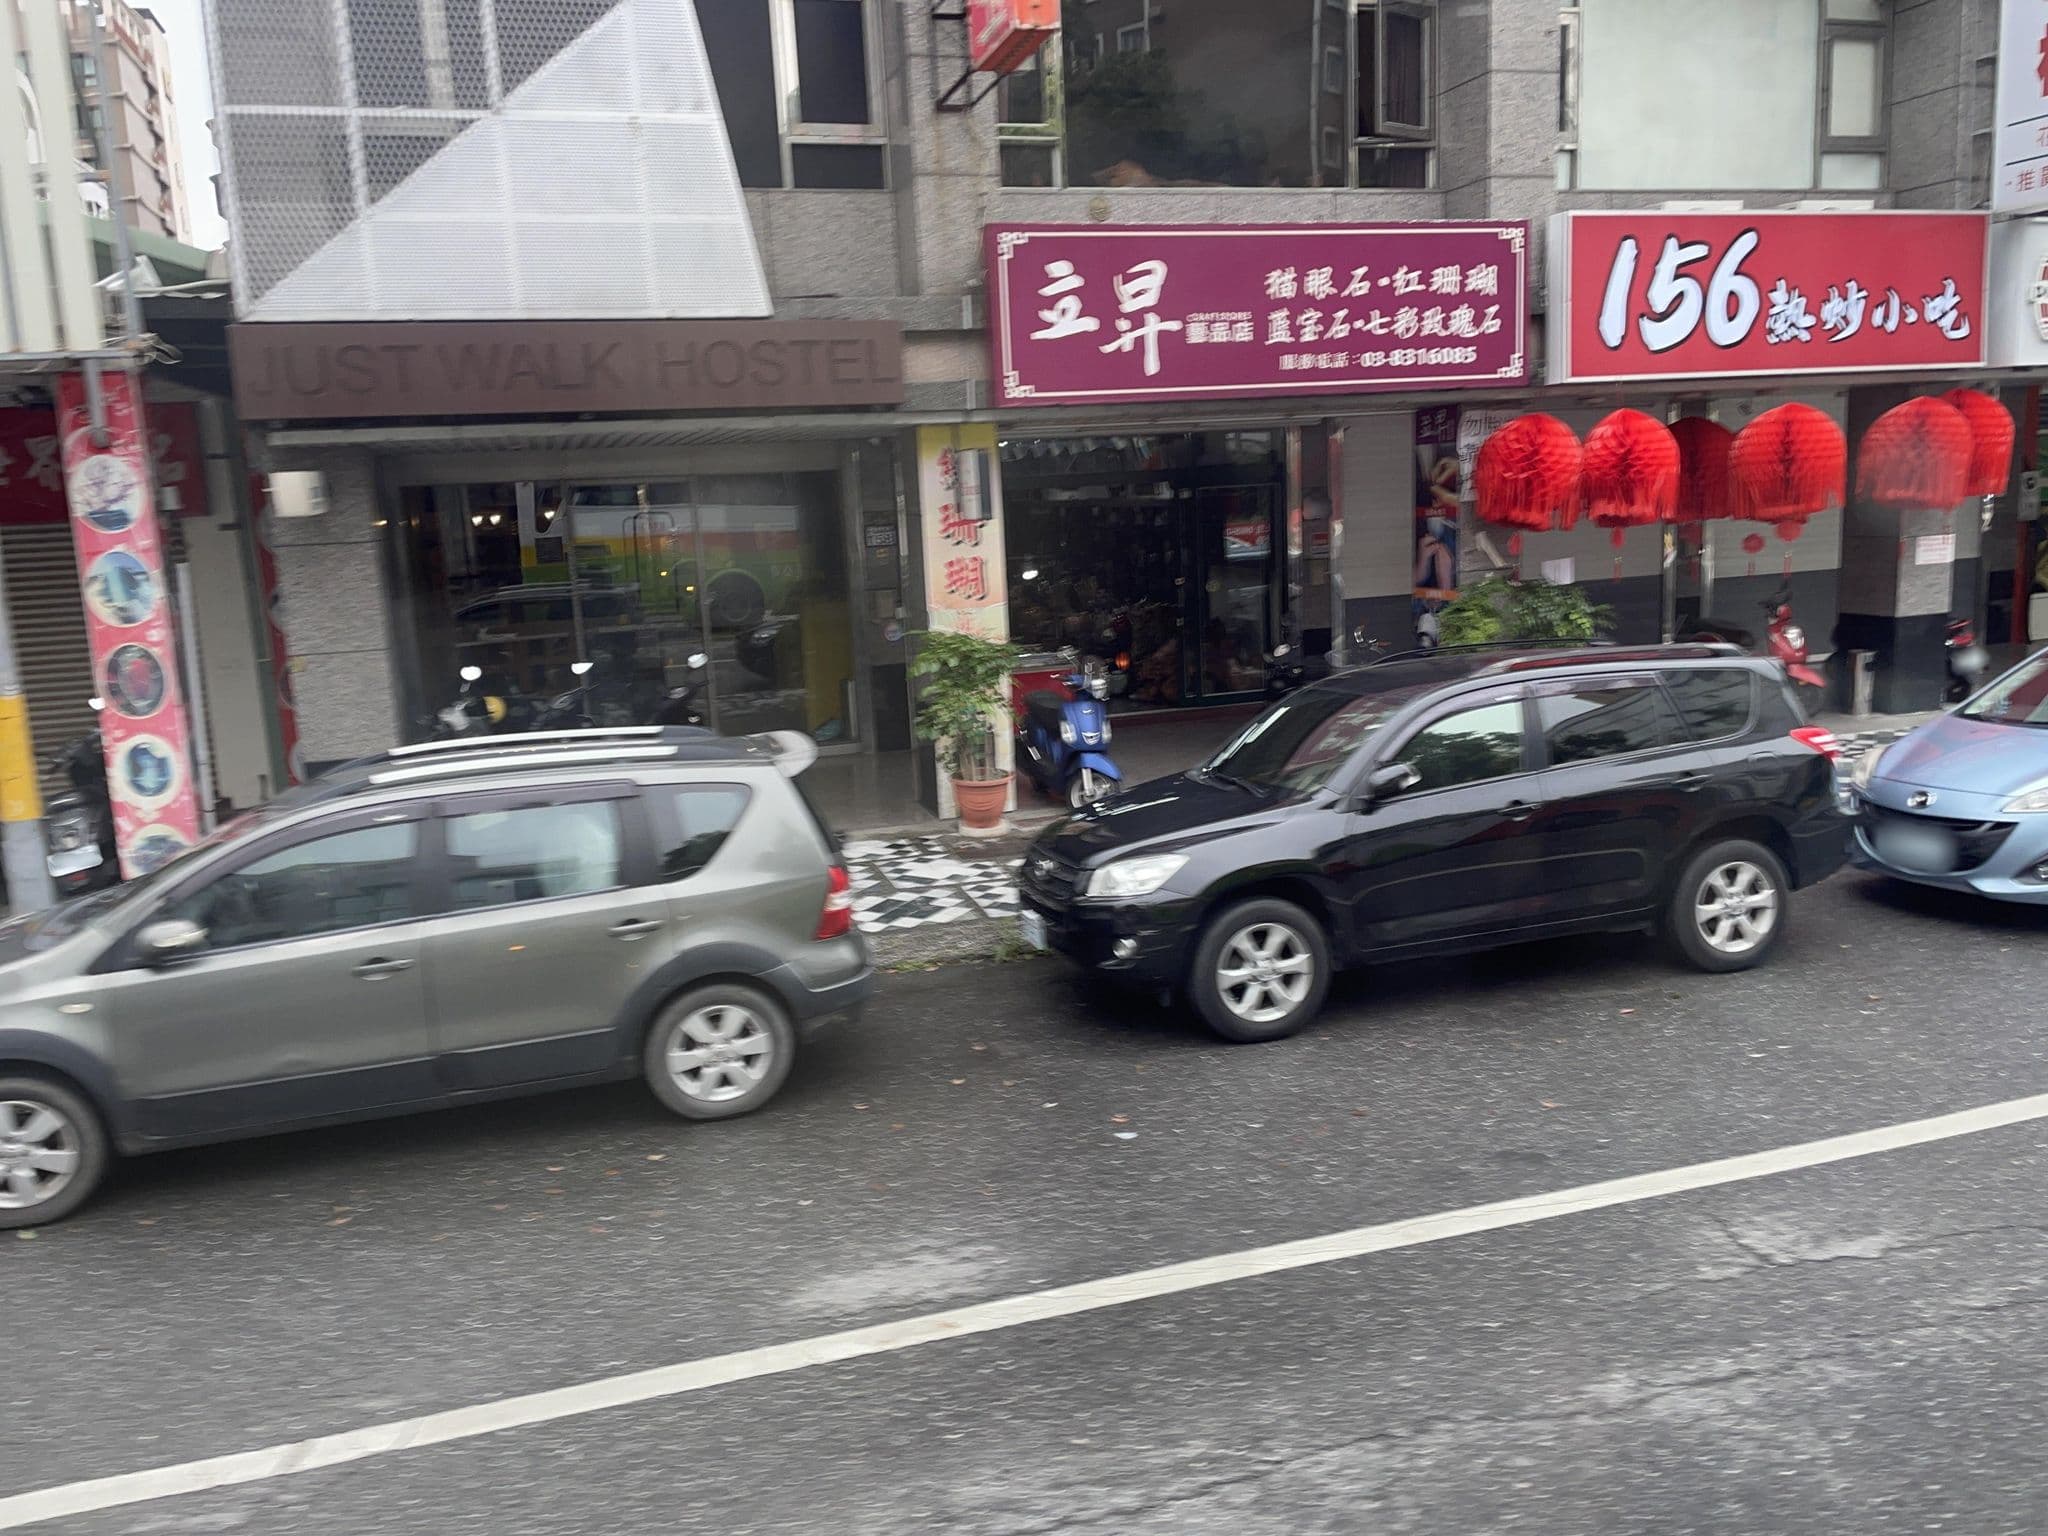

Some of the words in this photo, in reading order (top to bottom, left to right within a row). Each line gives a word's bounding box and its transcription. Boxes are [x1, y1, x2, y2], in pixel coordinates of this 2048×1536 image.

[1599, 228, 1761, 352] 156
[1766, 278, 1971, 344] 熱炒小吃
[248, 342, 421, 397] JUST
[433, 341, 625, 392] WALK
[655, 337, 899, 389] HOSTEL
